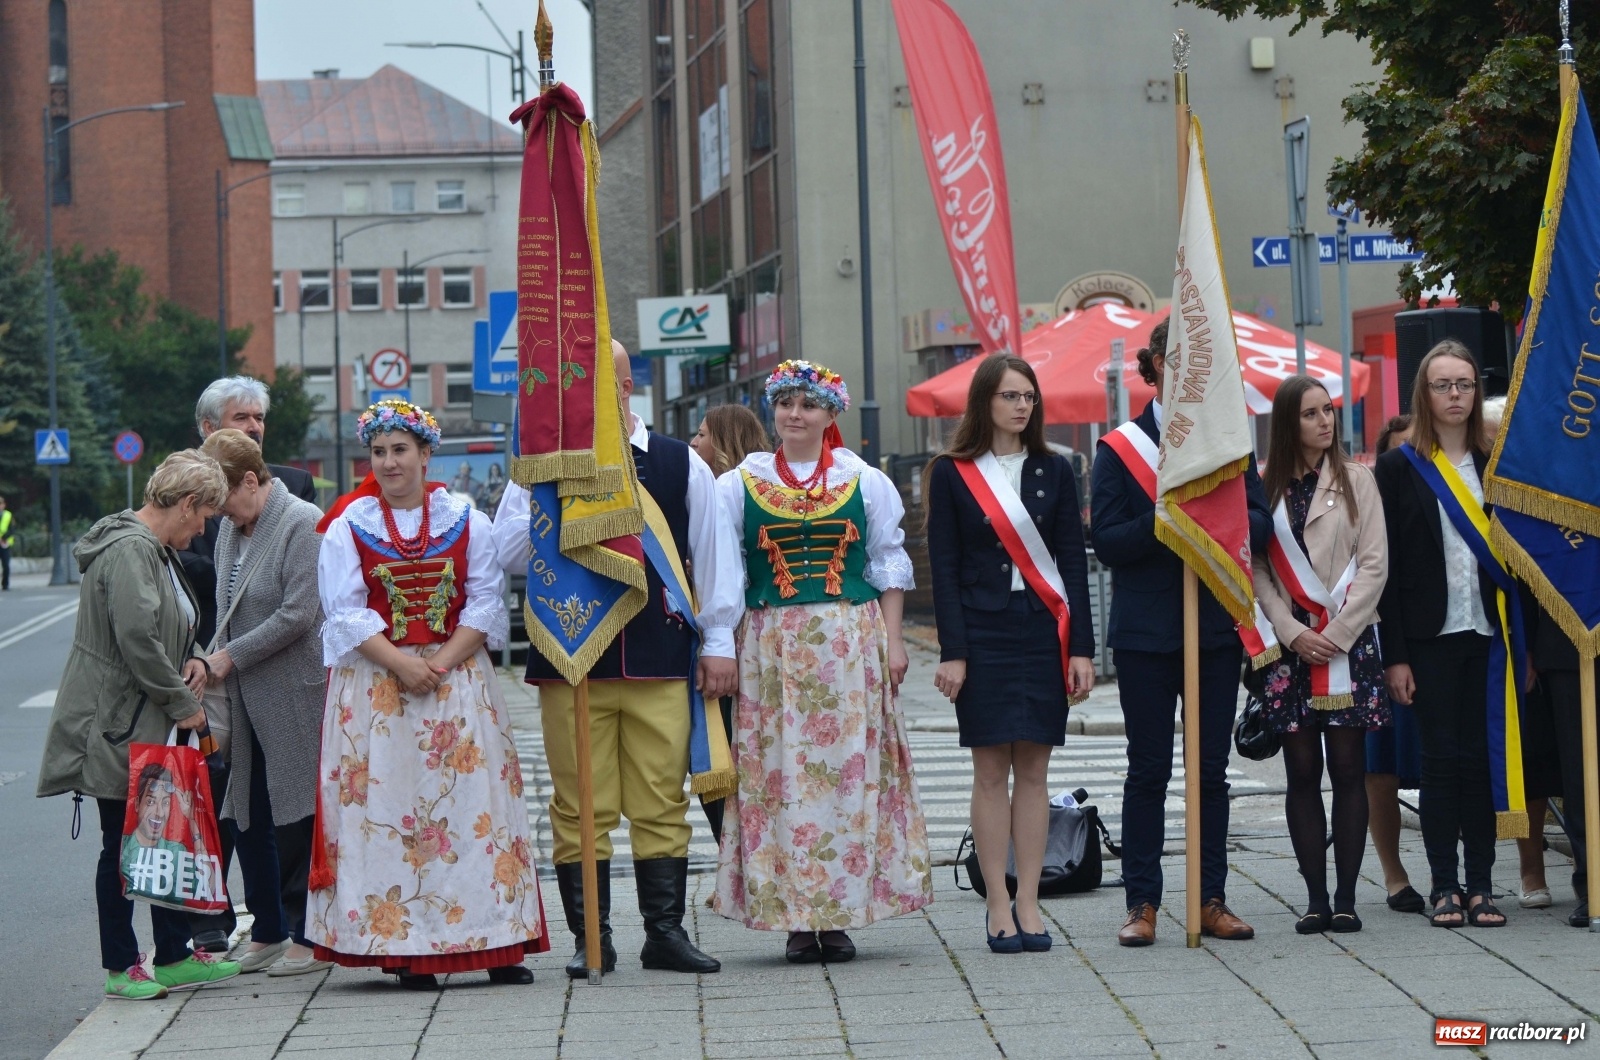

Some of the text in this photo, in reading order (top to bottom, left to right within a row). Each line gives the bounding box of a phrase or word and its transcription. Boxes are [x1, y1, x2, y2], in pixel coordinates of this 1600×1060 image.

[1271, 242, 1287, 260] ul.
[1354, 239, 1370, 257] ul.
[563, 299, 576, 307] DER
[1165, 411, 1195, 449] NR
